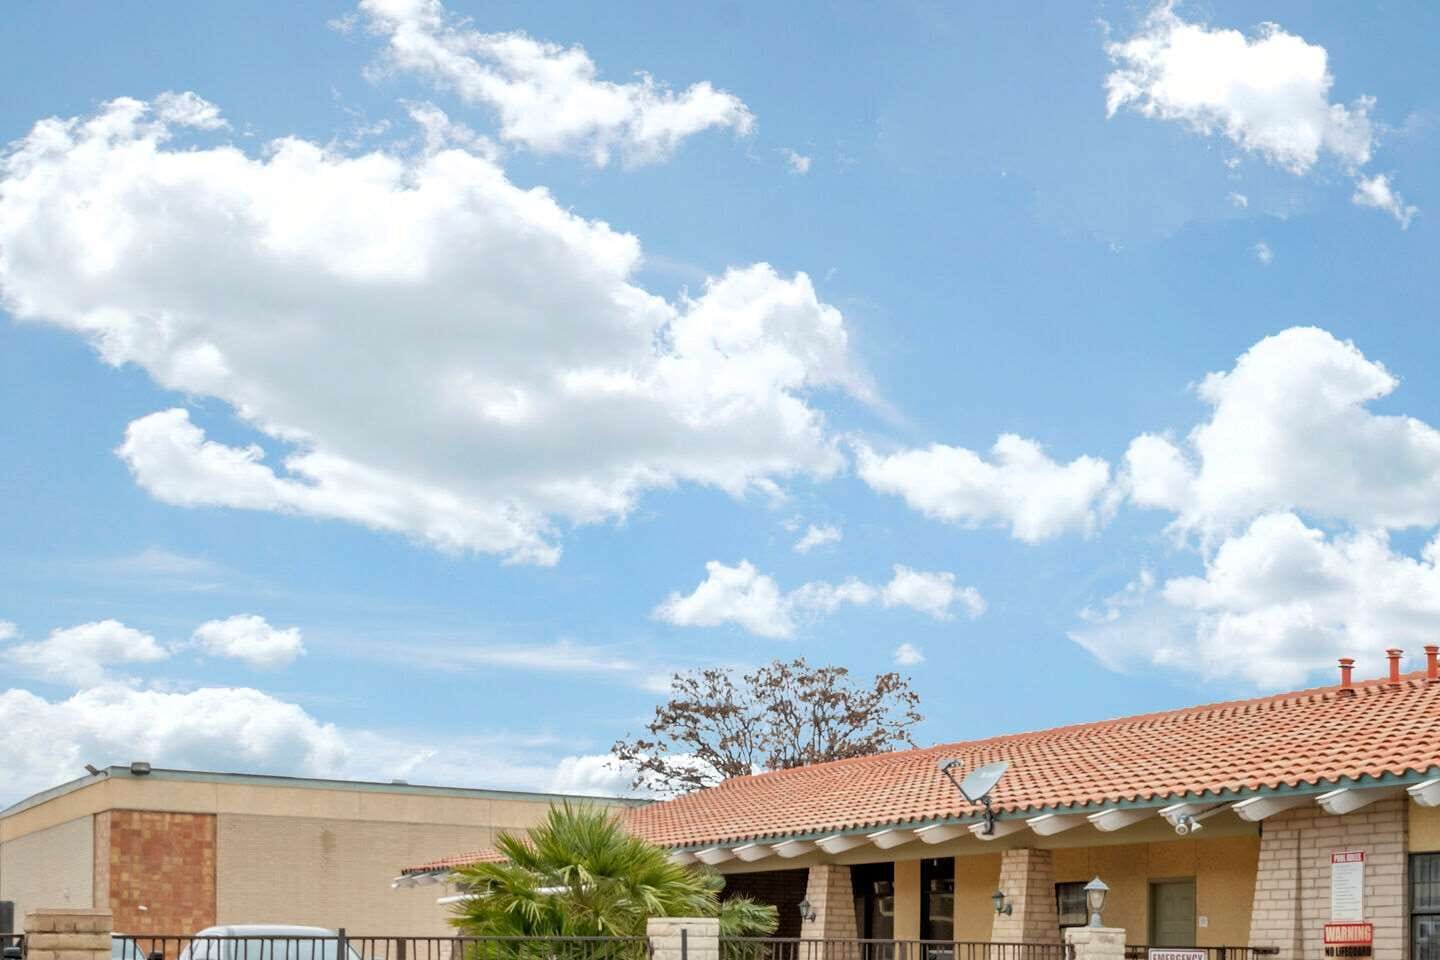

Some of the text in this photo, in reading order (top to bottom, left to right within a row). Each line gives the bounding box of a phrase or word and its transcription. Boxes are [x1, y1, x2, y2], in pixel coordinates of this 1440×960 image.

[1326, 926, 1371, 941] WARNING
[1325, 946, 1371, 957] NO LIFEGUARD
